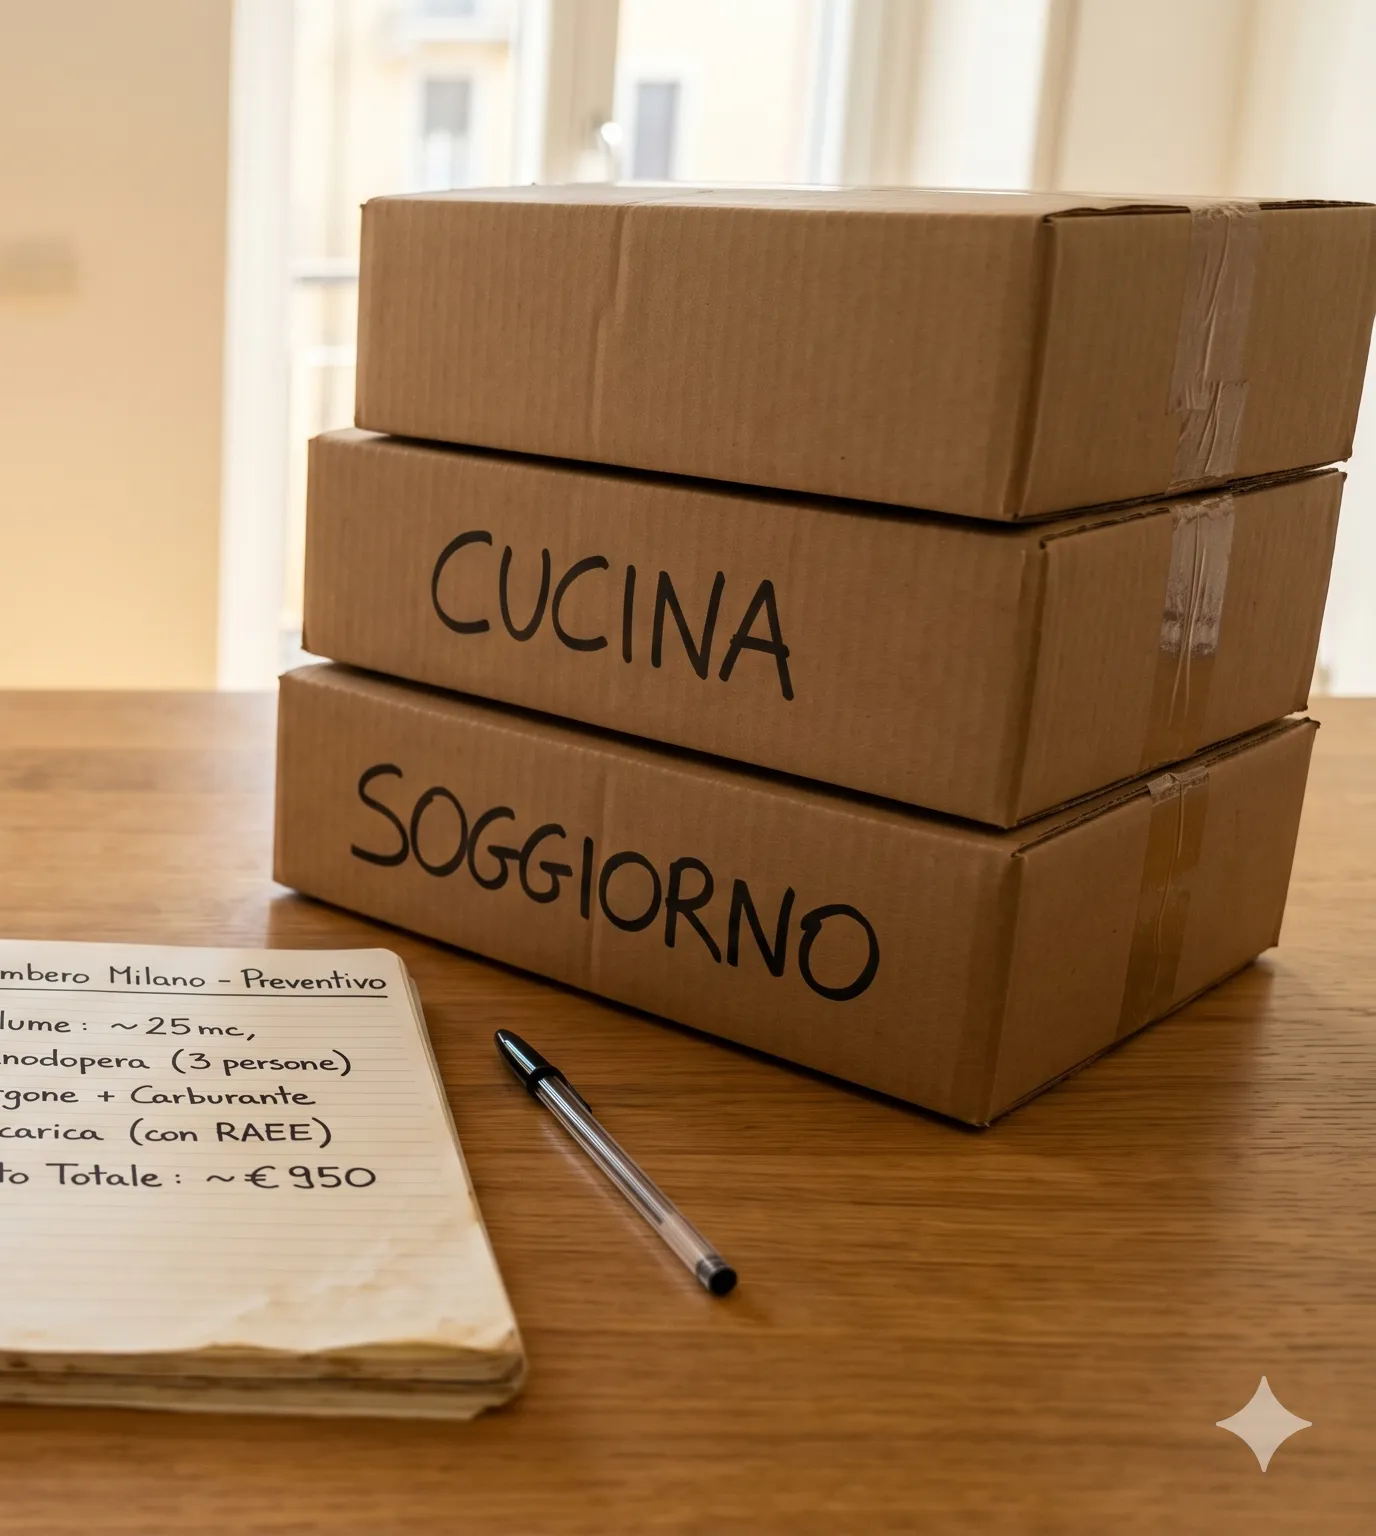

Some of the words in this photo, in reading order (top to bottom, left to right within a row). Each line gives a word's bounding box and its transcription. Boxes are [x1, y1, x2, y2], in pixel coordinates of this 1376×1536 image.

[430, 530, 795, 702] CUCINA
[350, 763, 880, 1002] SOGGIORNO
[107, 965, 206, 989] Milano
[239, 967, 388, 991] Preventivo
[171, 1048, 212, 1075] (3
[222, 1048, 352, 1077] persone)
[96, 1090, 116, 1103] +
[130, 1084, 317, 1107] Carburante
[129, 1117, 199, 1147] (con
[215, 1117, 332, 1149] RAEE)
